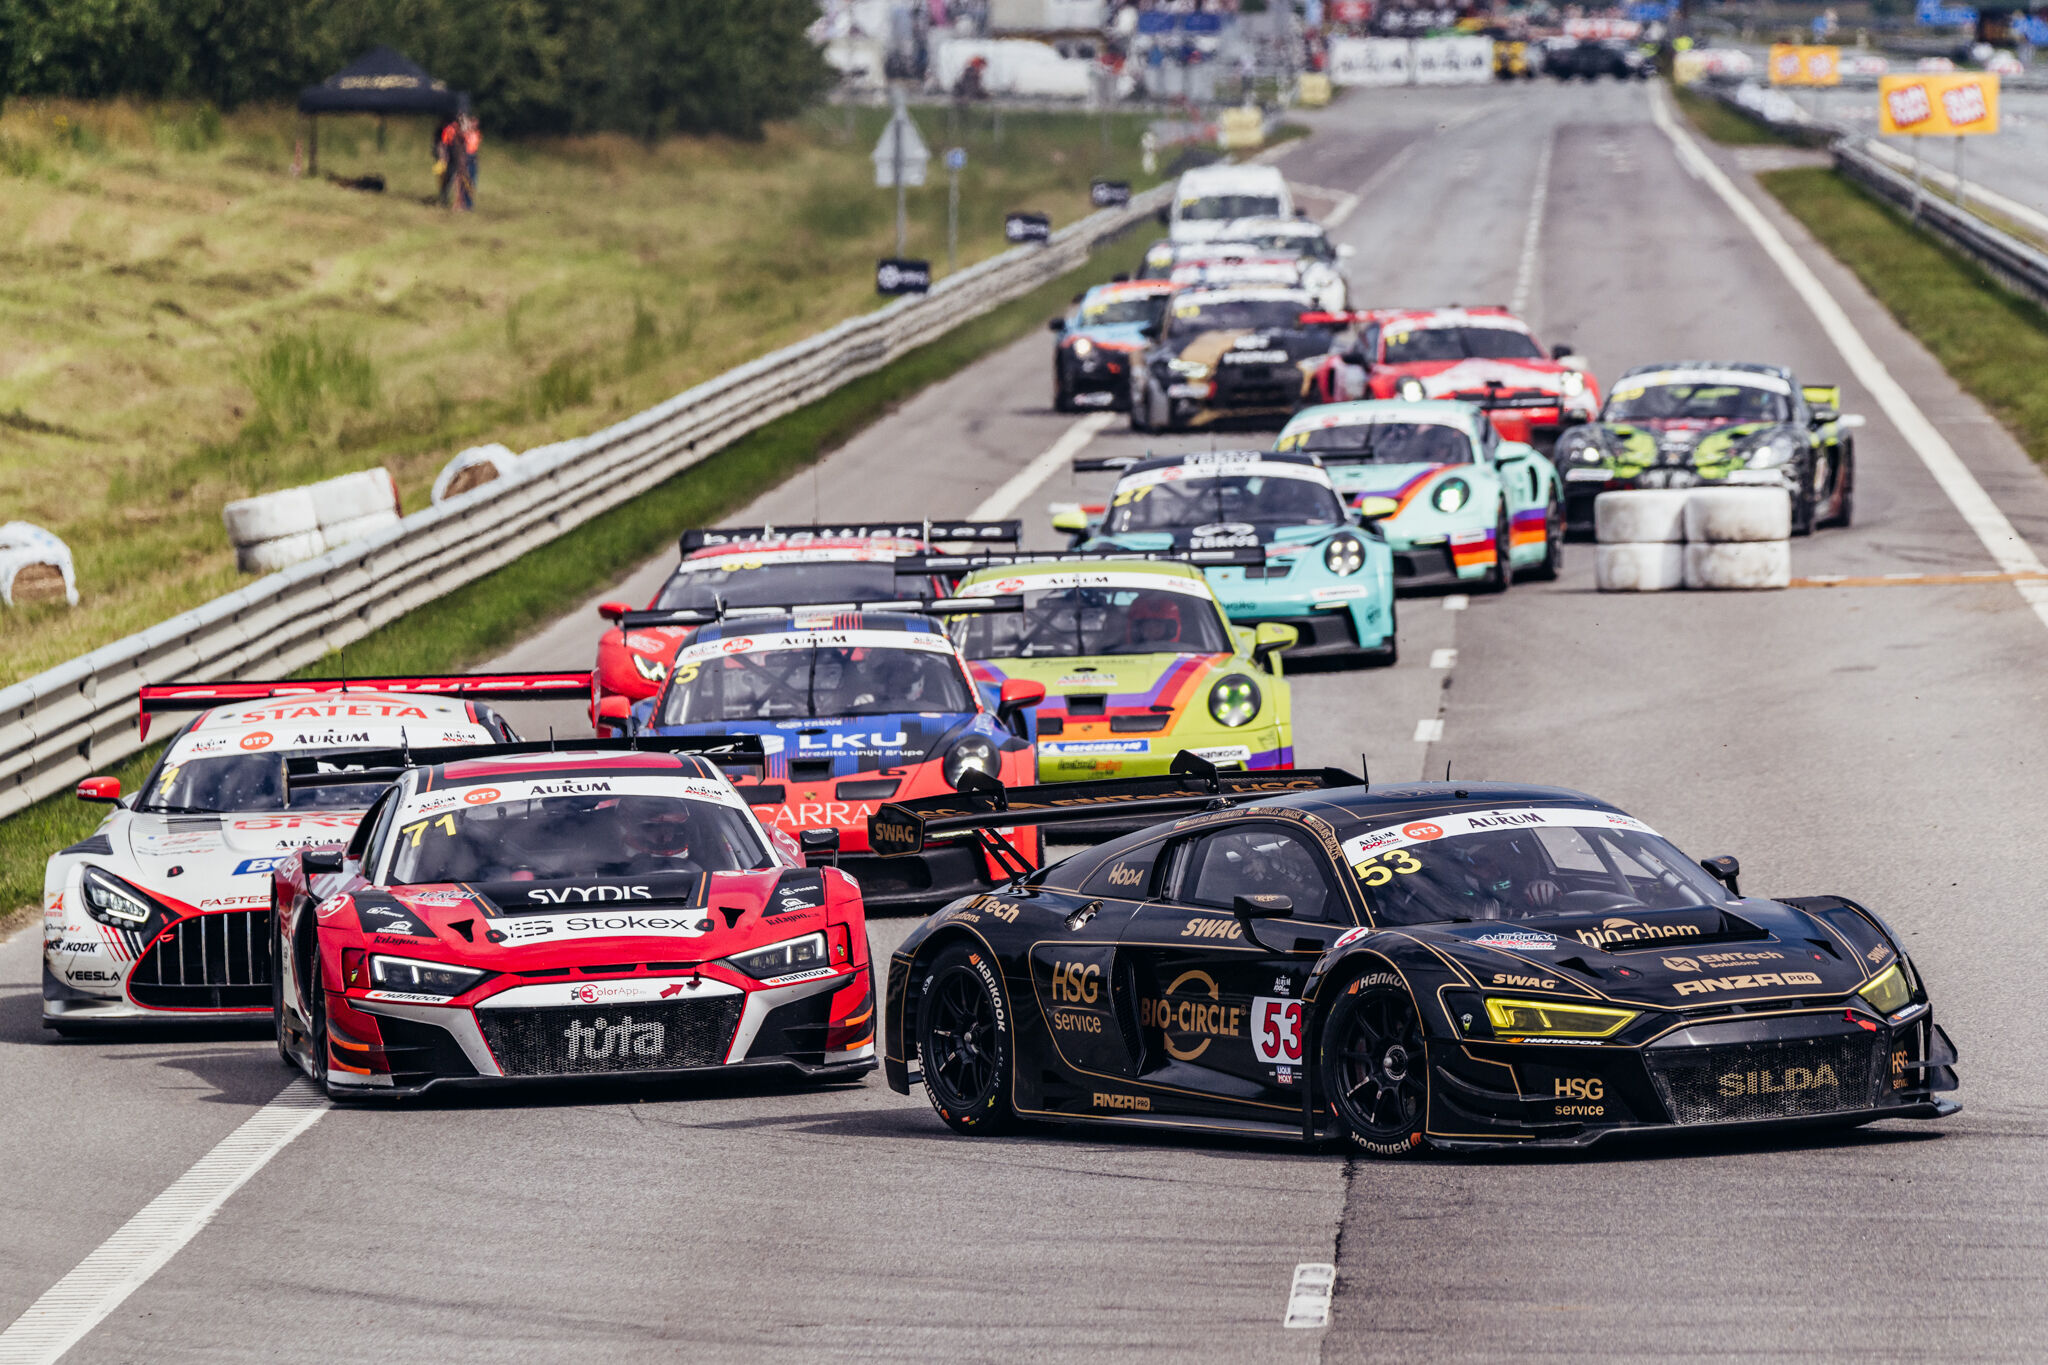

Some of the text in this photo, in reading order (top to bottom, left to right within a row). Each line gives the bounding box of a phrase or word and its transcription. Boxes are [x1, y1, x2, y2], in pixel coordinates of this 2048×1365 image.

[780, 634, 848, 646] AURUM
[675, 661, 702, 684] 5
[242, 705, 428, 724] STATETA
[243, 736, 270, 746] GT3
[293, 732, 369, 744] AURUM
[799, 732, 908, 749] LKU
[160, 768, 181, 794] 1
[530, 782, 611, 796] AURUM
[468, 790, 498, 802] GT3
[1467, 812, 1546, 829] AURUM
[402, 814, 457, 848] 71
[875, 823, 914, 843] SWAG
[1359, 831, 1396, 847] AURUM
[1408, 826, 1439, 837] GT3
[1354, 849, 1423, 887] 53
[528, 885, 652, 904] SVYDIS
[567, 916, 690, 931] Stokex
[1181, 918, 1243, 940] SWAG
[1476, 932, 1558, 942] AURUM
[1576, 922, 1701, 949] bio-chem
[1697, 951, 1785, 964] EMTech
[1709, 960, 1760, 969] Solutions
[65, 971, 121, 981] VEESLA
[1052, 961, 1101, 1004] HSG
[1493, 974, 1556, 989] SWAG
[1672, 974, 1815, 996] ANZA PRO
[1054, 1012, 1102, 1034] service
[1261, 1002, 1302, 1060] 53
[1555, 1078, 1604, 1100] HSG
[1717, 1064, 1839, 1097] SILDA
[1093, 1092, 1135, 1109] ANZA
[1555, 1105, 1604, 1116] service
